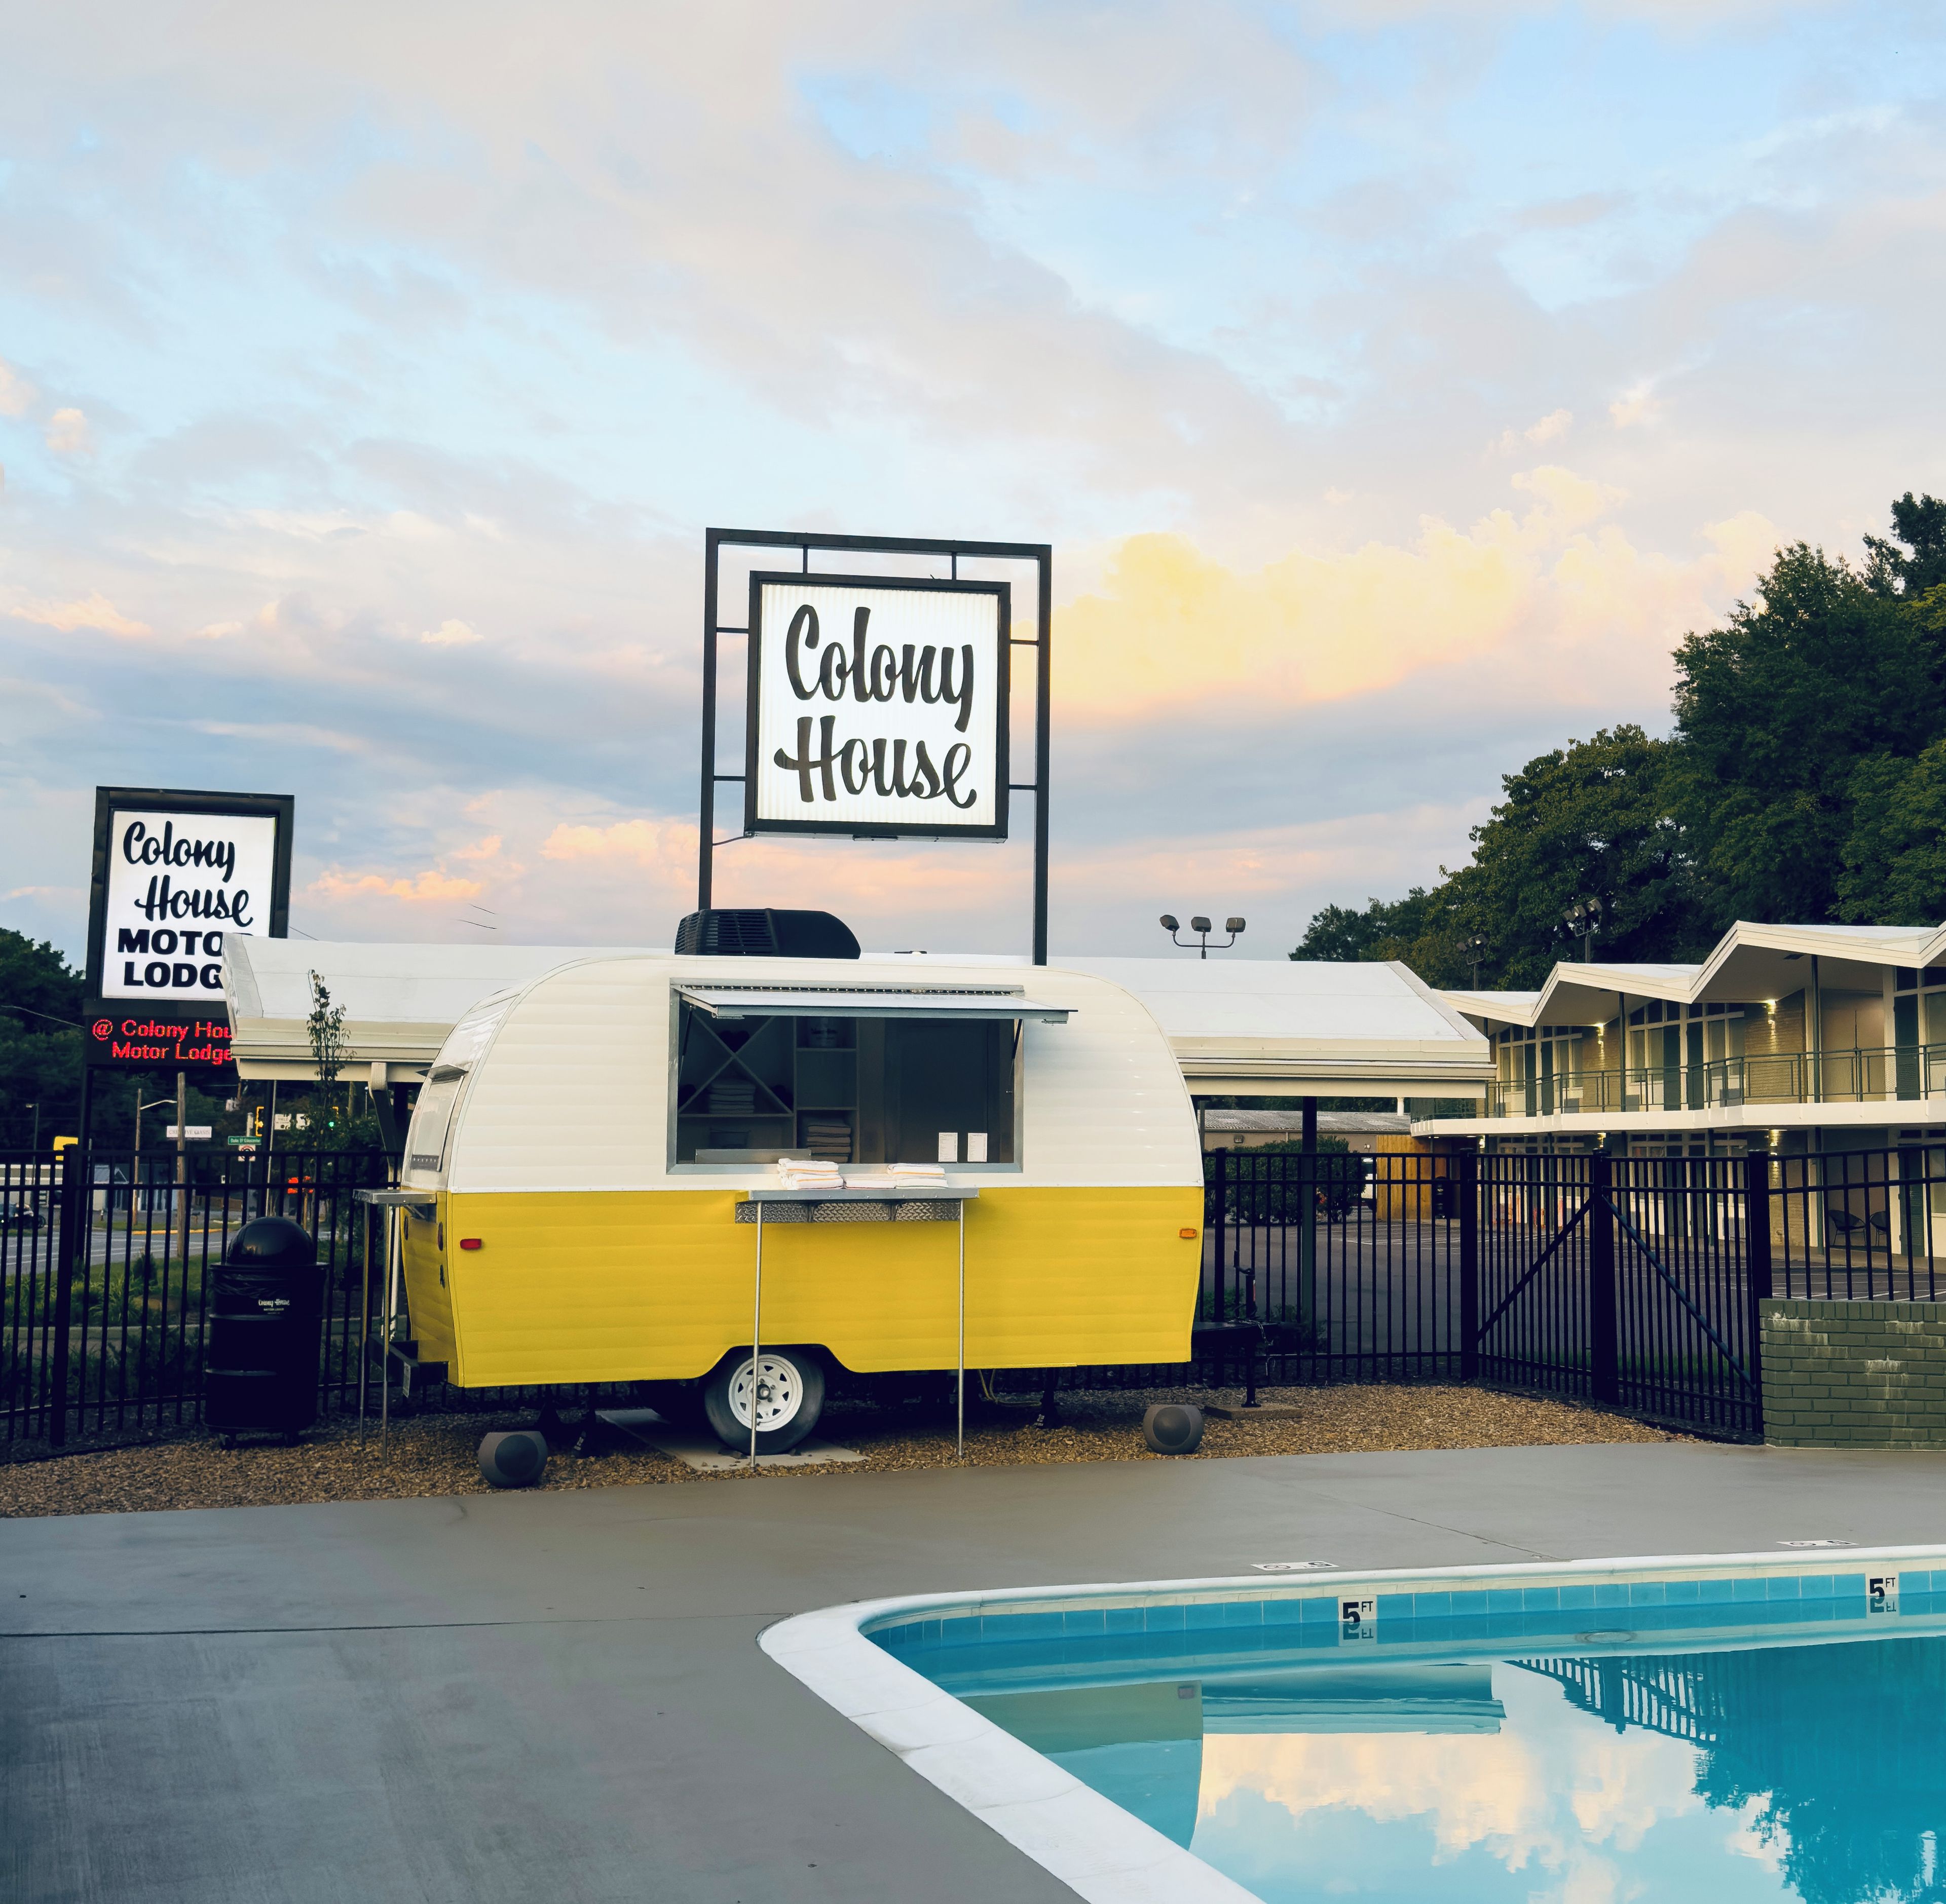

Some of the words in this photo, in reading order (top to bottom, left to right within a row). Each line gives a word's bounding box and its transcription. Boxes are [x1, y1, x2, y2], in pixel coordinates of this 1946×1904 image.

[786, 604, 974, 732] Colony
[774, 715, 977, 809] House
[124, 821, 235, 883] Colony
[134, 875, 253, 927] House
[118, 929, 254, 957] MOTO
[124, 962, 224, 989] LODG
[92, 1019, 113, 1041] @
[122, 1020, 189, 1042] Colony
[195, 1021, 232, 1038] Hou
[112, 1042, 169, 1059] Motor
[175, 1043, 232, 1064] Lodge
[1869, 1578, 1885, 1597] 5
[1886, 1578, 1895, 1587] FT
[1343, 1602, 1361, 1623] 5
[1362, 1601, 1373, 1612] FT
